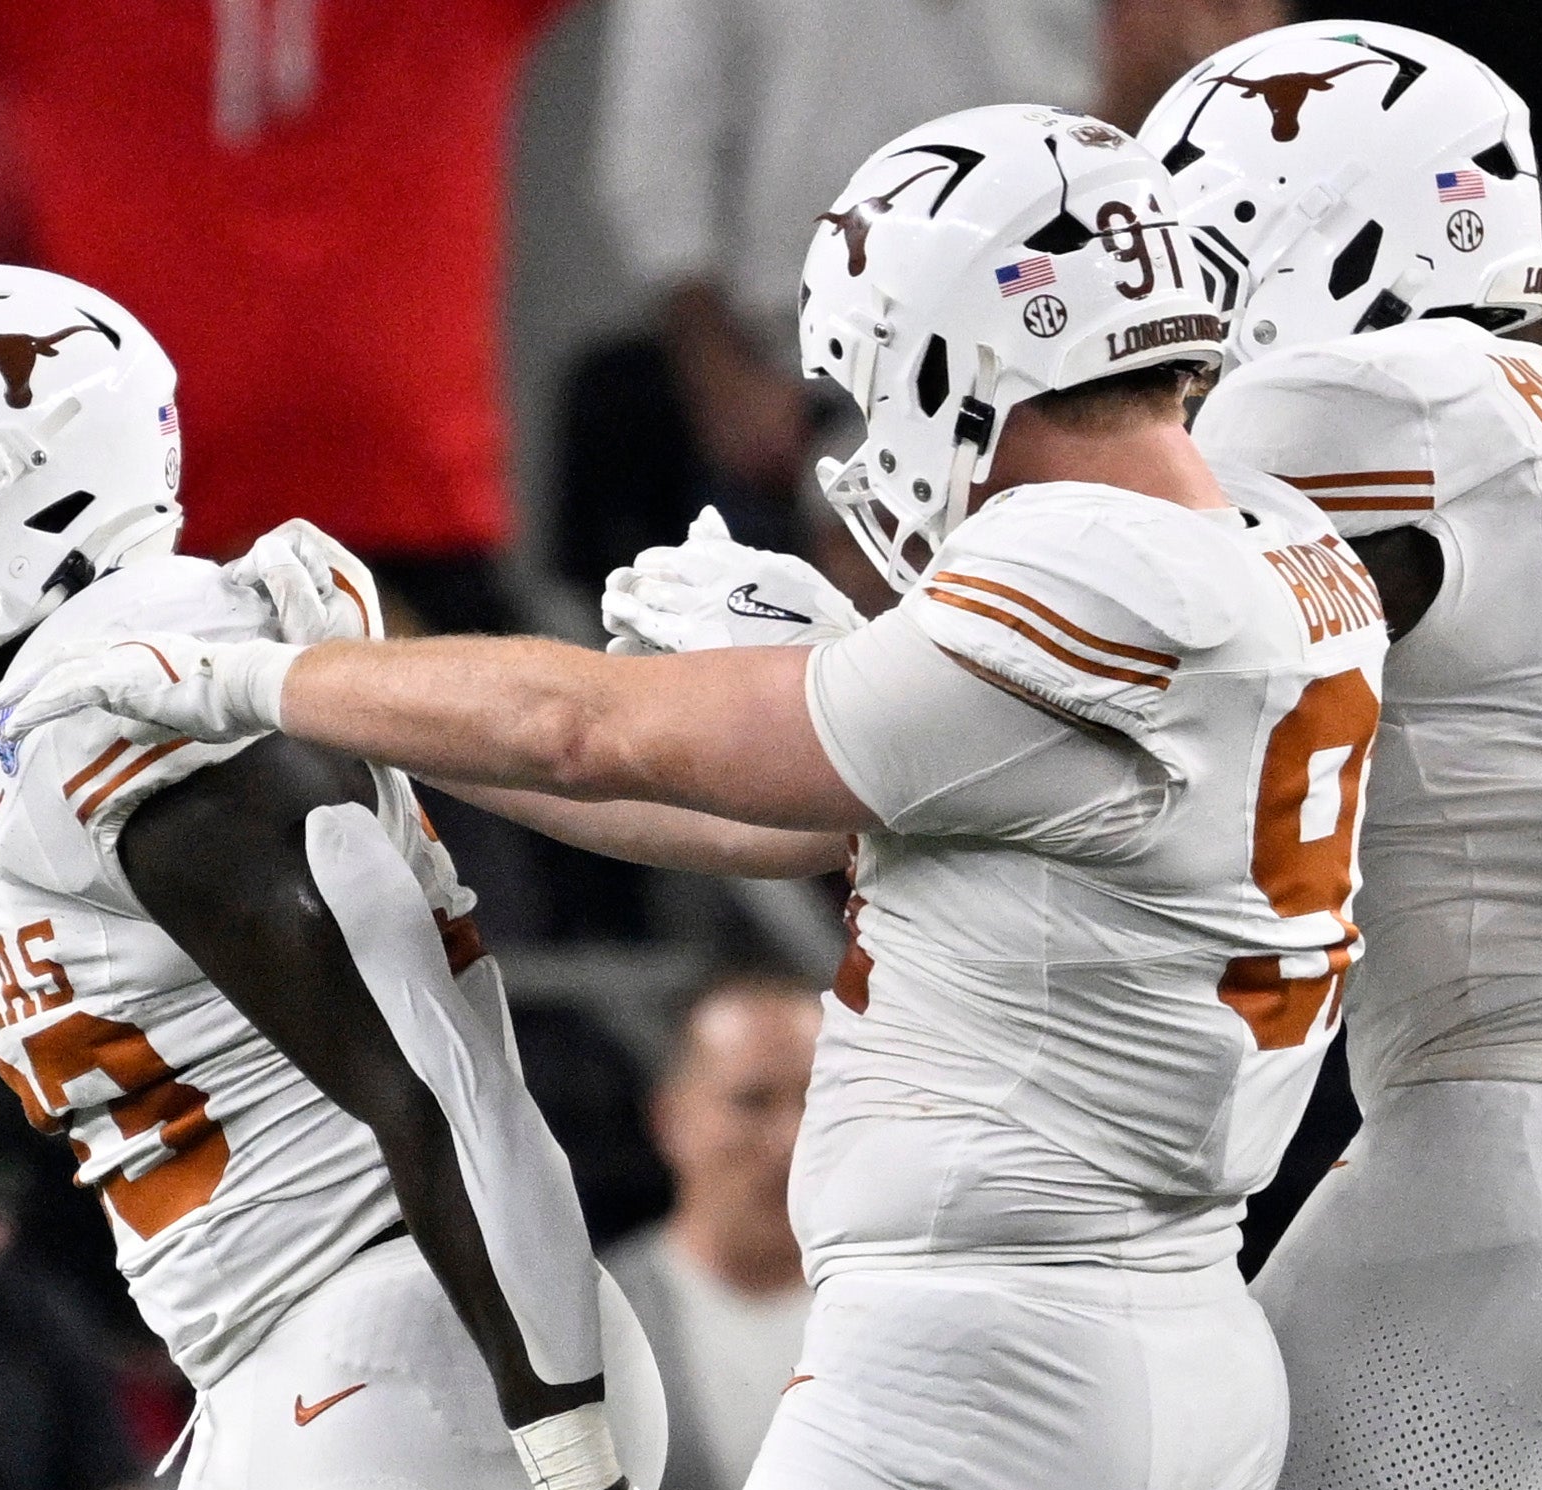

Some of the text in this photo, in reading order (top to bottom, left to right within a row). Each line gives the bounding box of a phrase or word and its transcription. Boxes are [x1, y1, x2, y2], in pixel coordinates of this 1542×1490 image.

[1096, 192, 1185, 301] 91
[1447, 211, 1484, 251] SEC
[1024, 295, 1068, 338] SEC
